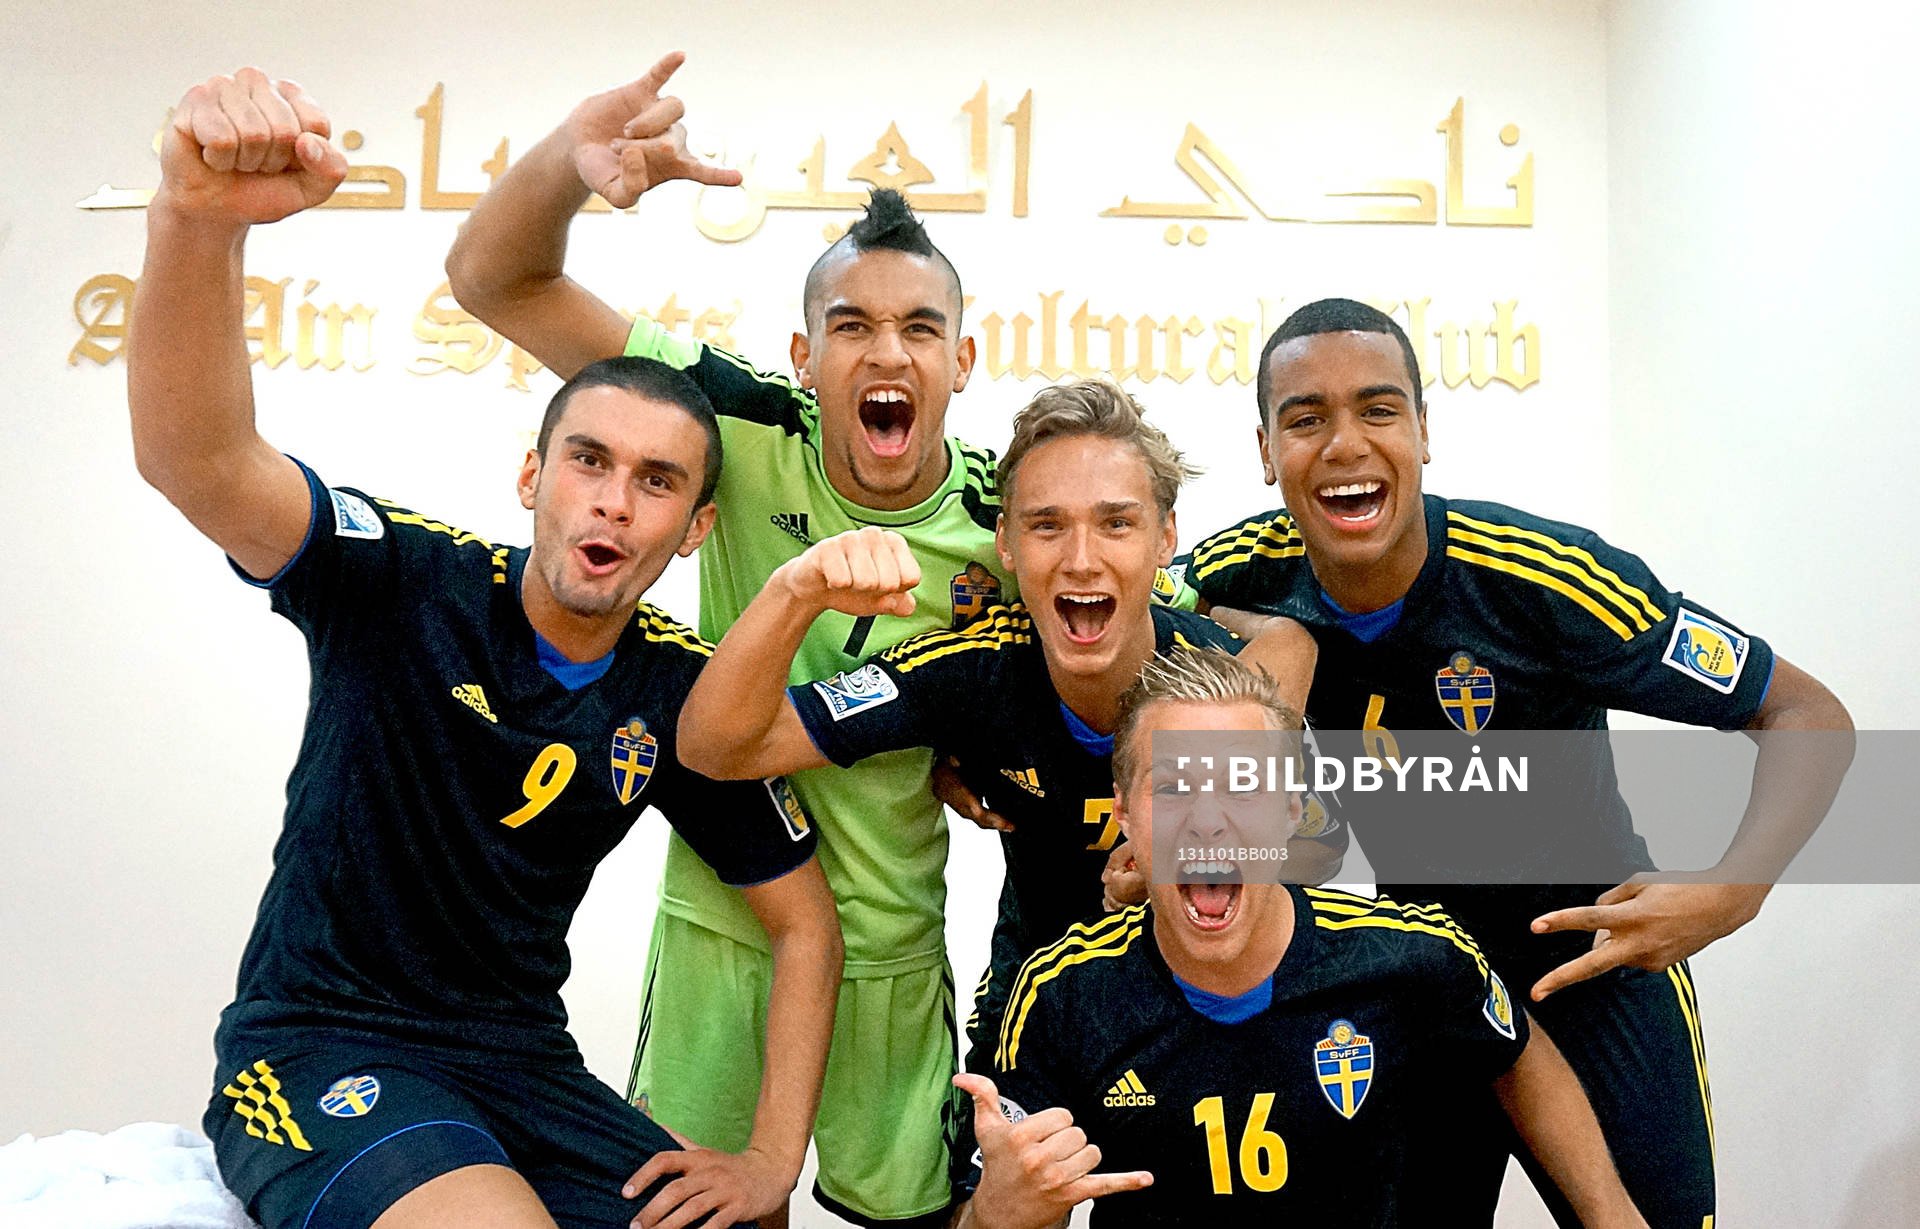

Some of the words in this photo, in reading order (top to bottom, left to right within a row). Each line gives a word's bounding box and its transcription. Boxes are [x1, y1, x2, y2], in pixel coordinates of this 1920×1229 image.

[1098, 95, 1535, 247] نادي
[1374, 297, 1542, 393] lub
[500, 743, 577, 828] 9
[1329, 1048, 1360, 1059] SvFF
[1103, 1093, 1156, 1107] adidas
[1193, 1092, 1289, 1195] 16
